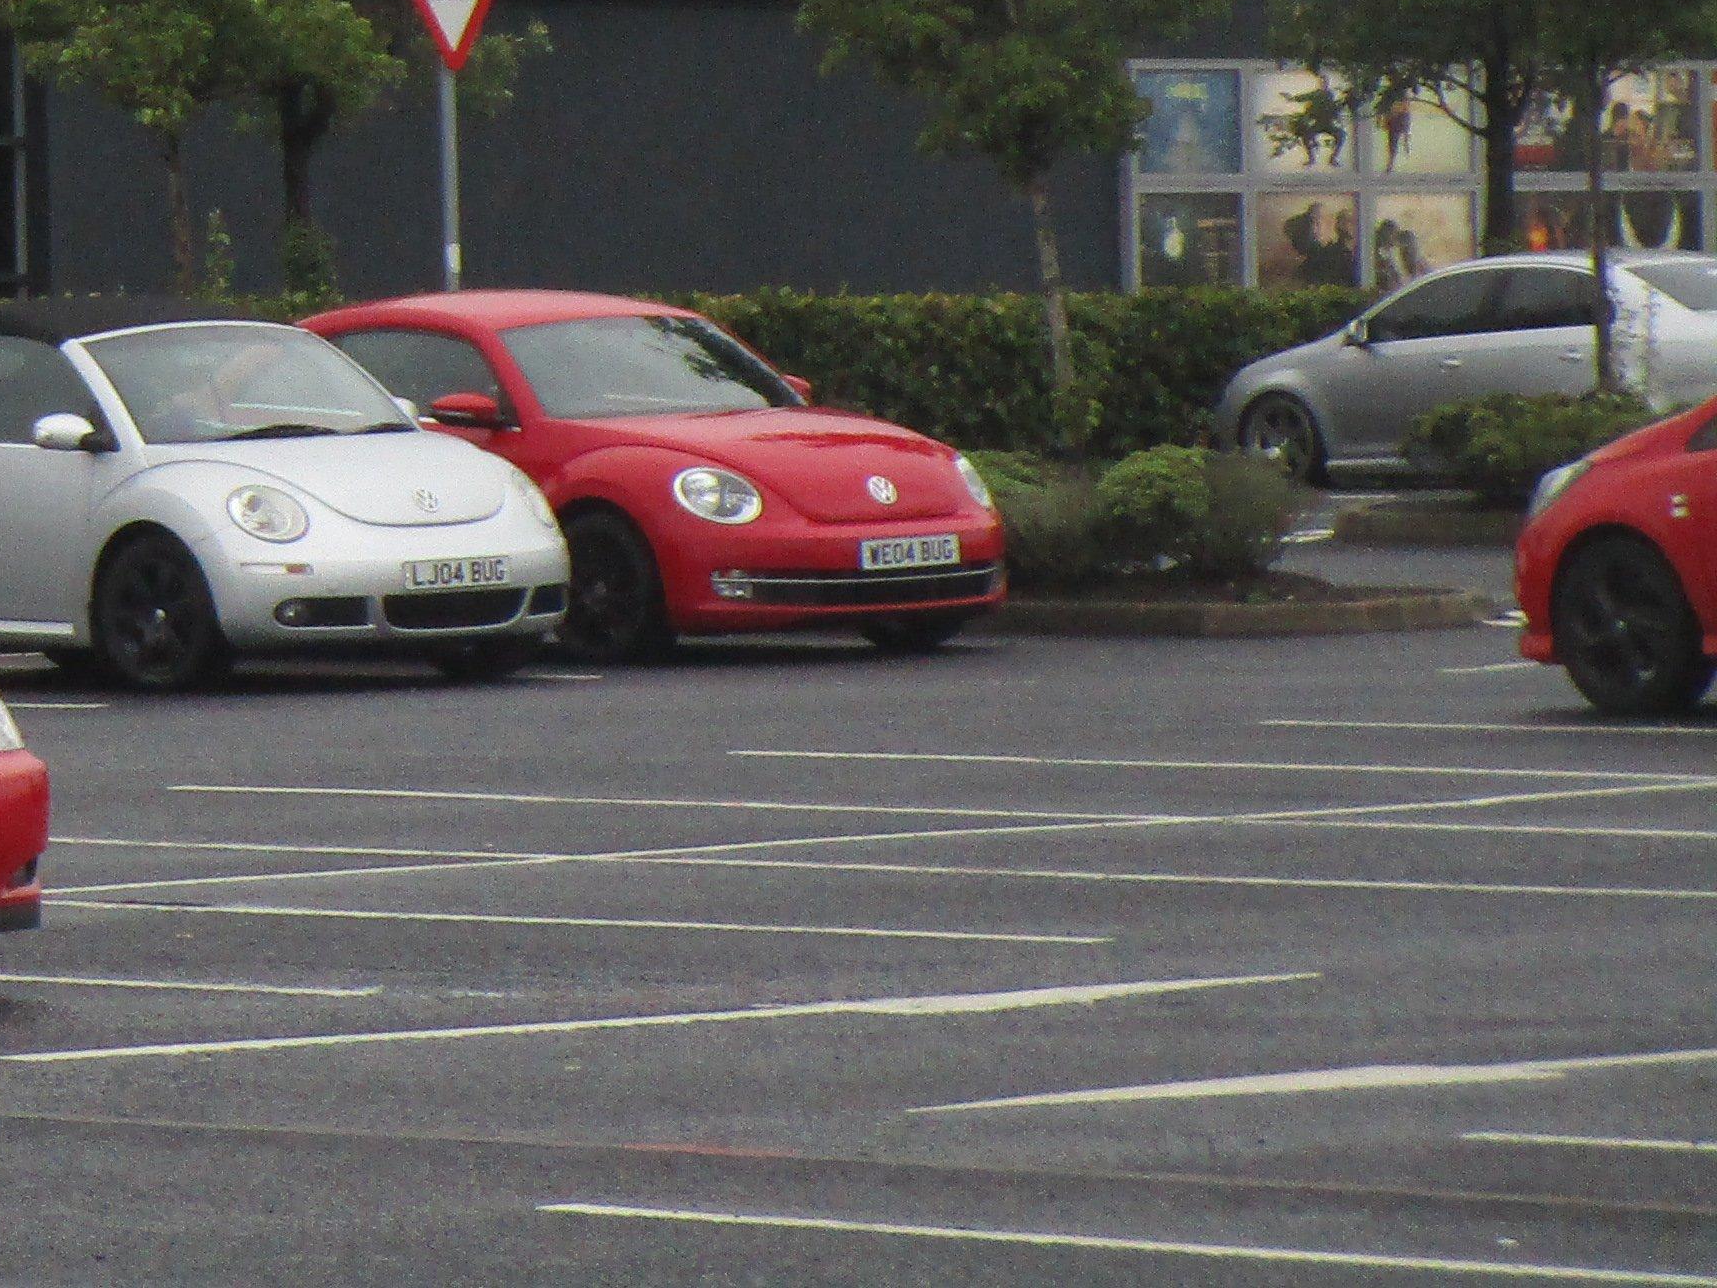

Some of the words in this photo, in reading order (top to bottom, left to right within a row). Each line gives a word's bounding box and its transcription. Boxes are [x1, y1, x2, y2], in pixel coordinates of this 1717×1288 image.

[921, 539, 954, 561] BUG
[412, 562, 464, 585] LJ04
[471, 559, 506, 582] BUG
